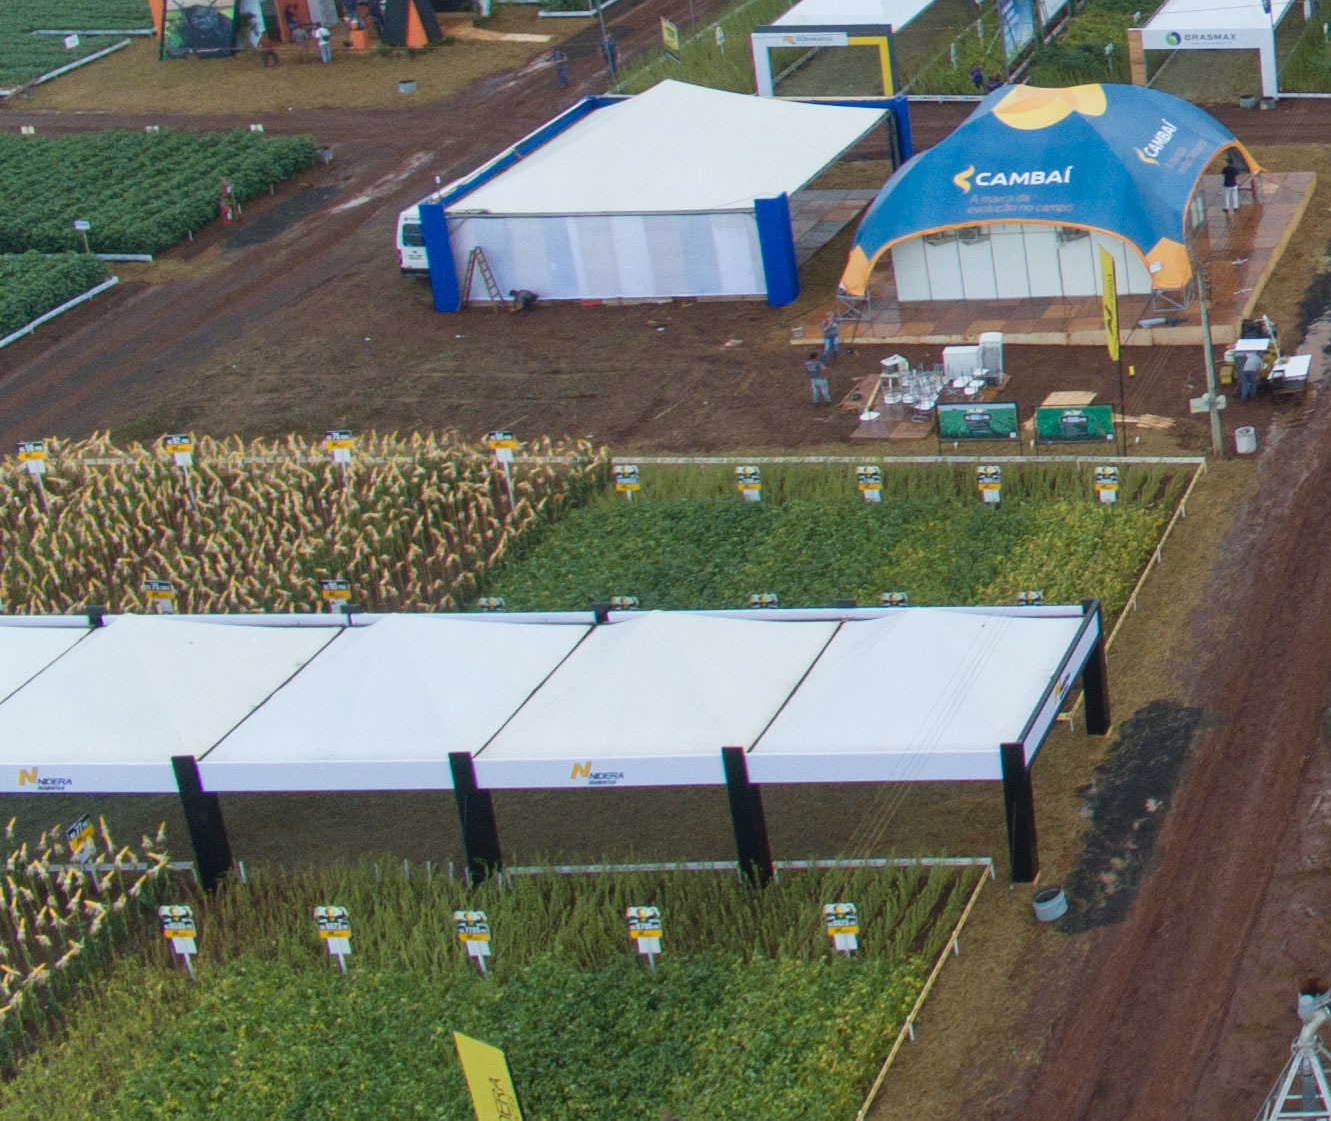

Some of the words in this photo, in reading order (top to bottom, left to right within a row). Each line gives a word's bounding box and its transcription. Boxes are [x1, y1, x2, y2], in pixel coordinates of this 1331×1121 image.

[1184, 33, 1237, 41] BRASMAX
[1144, 118, 1178, 157] CAMBAÍ
[975, 165, 1074, 187] CAMBAÍ
[969, 194, 979, 203] A
[981, 196, 1014, 204] marca
[1017, 194, 1031, 203] da
[967, 203, 1017, 215] evolução
[1018, 205, 1034, 213] no
[1035, 204, 1074, 214] campo
